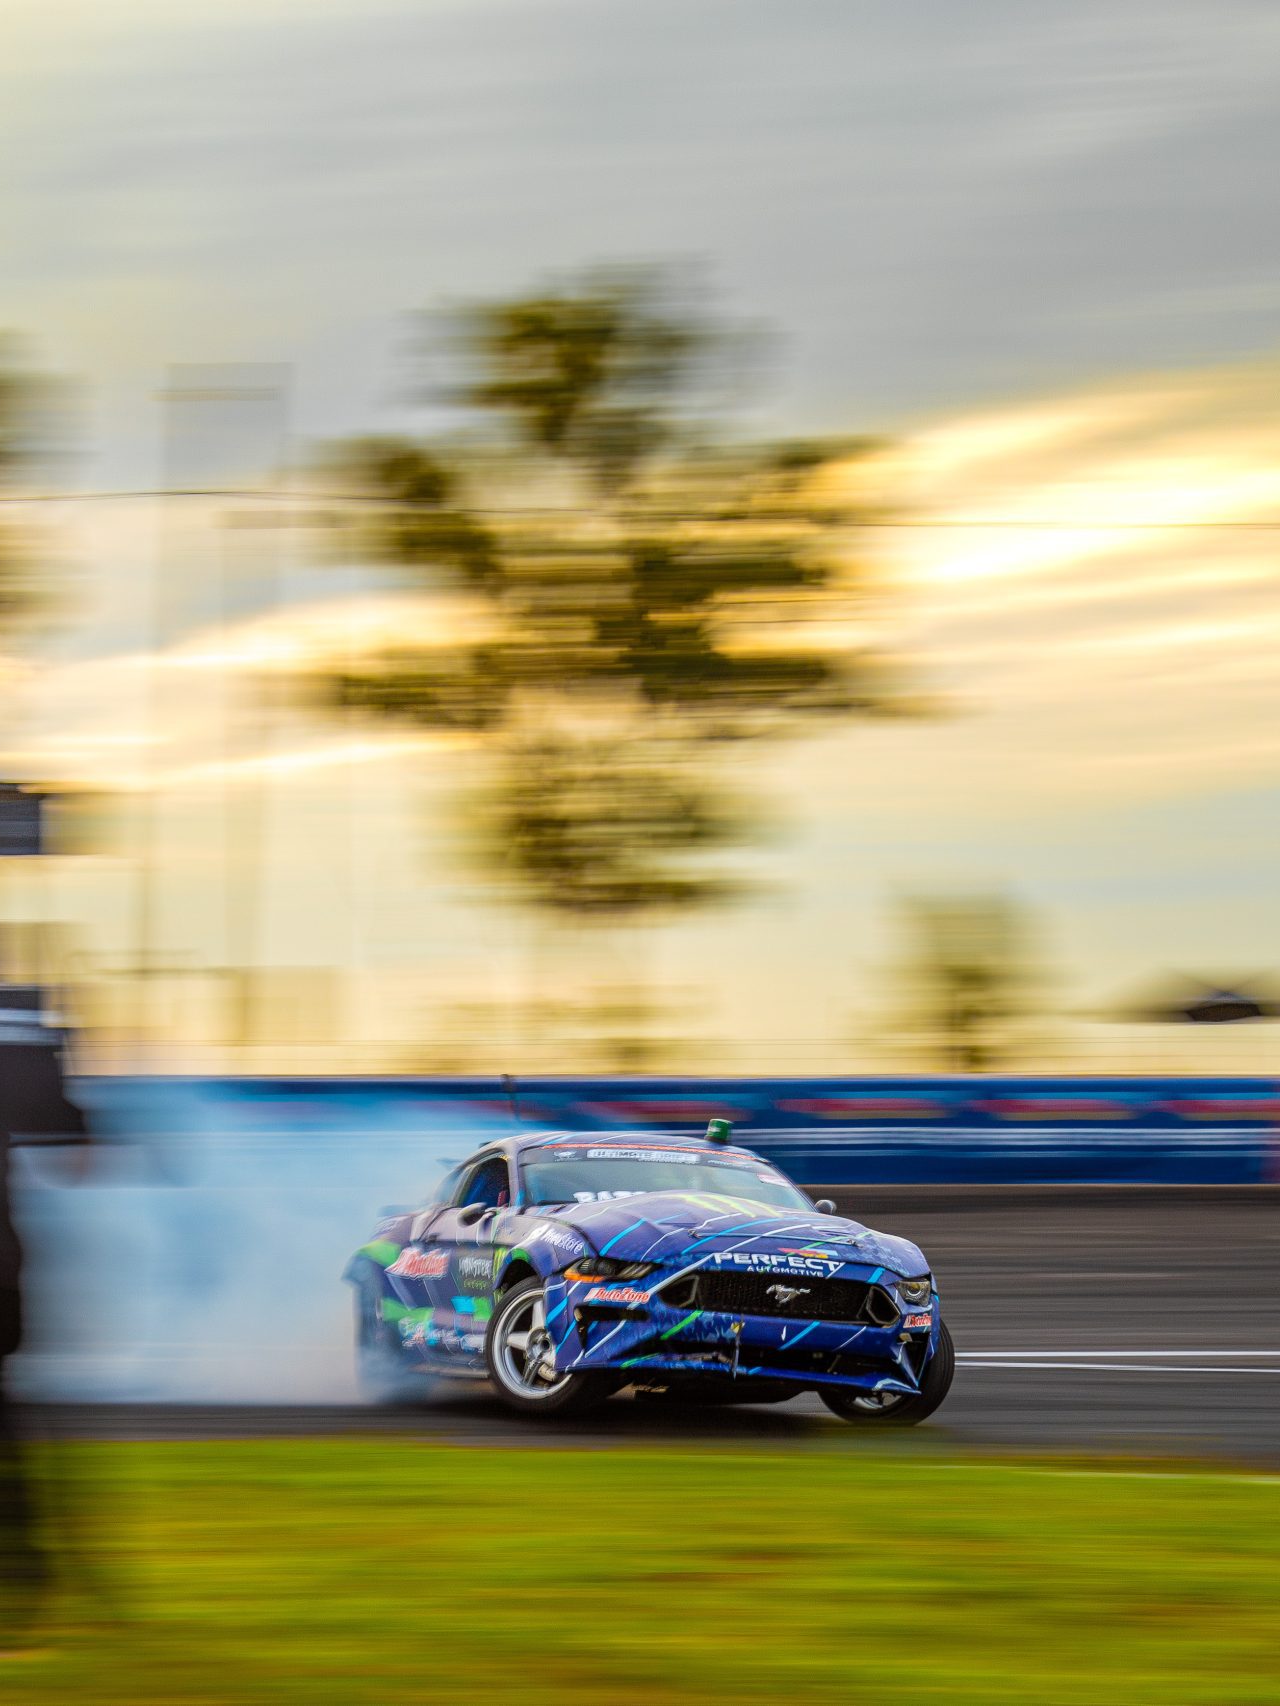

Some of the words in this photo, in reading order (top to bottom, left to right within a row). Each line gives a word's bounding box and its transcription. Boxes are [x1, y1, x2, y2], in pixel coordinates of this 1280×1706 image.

[713, 1252, 840, 1273] PERFECT
[746, 1265, 824, 1278] AUTOMOTIVE
[592, 1286, 651, 1305] AutoZone
